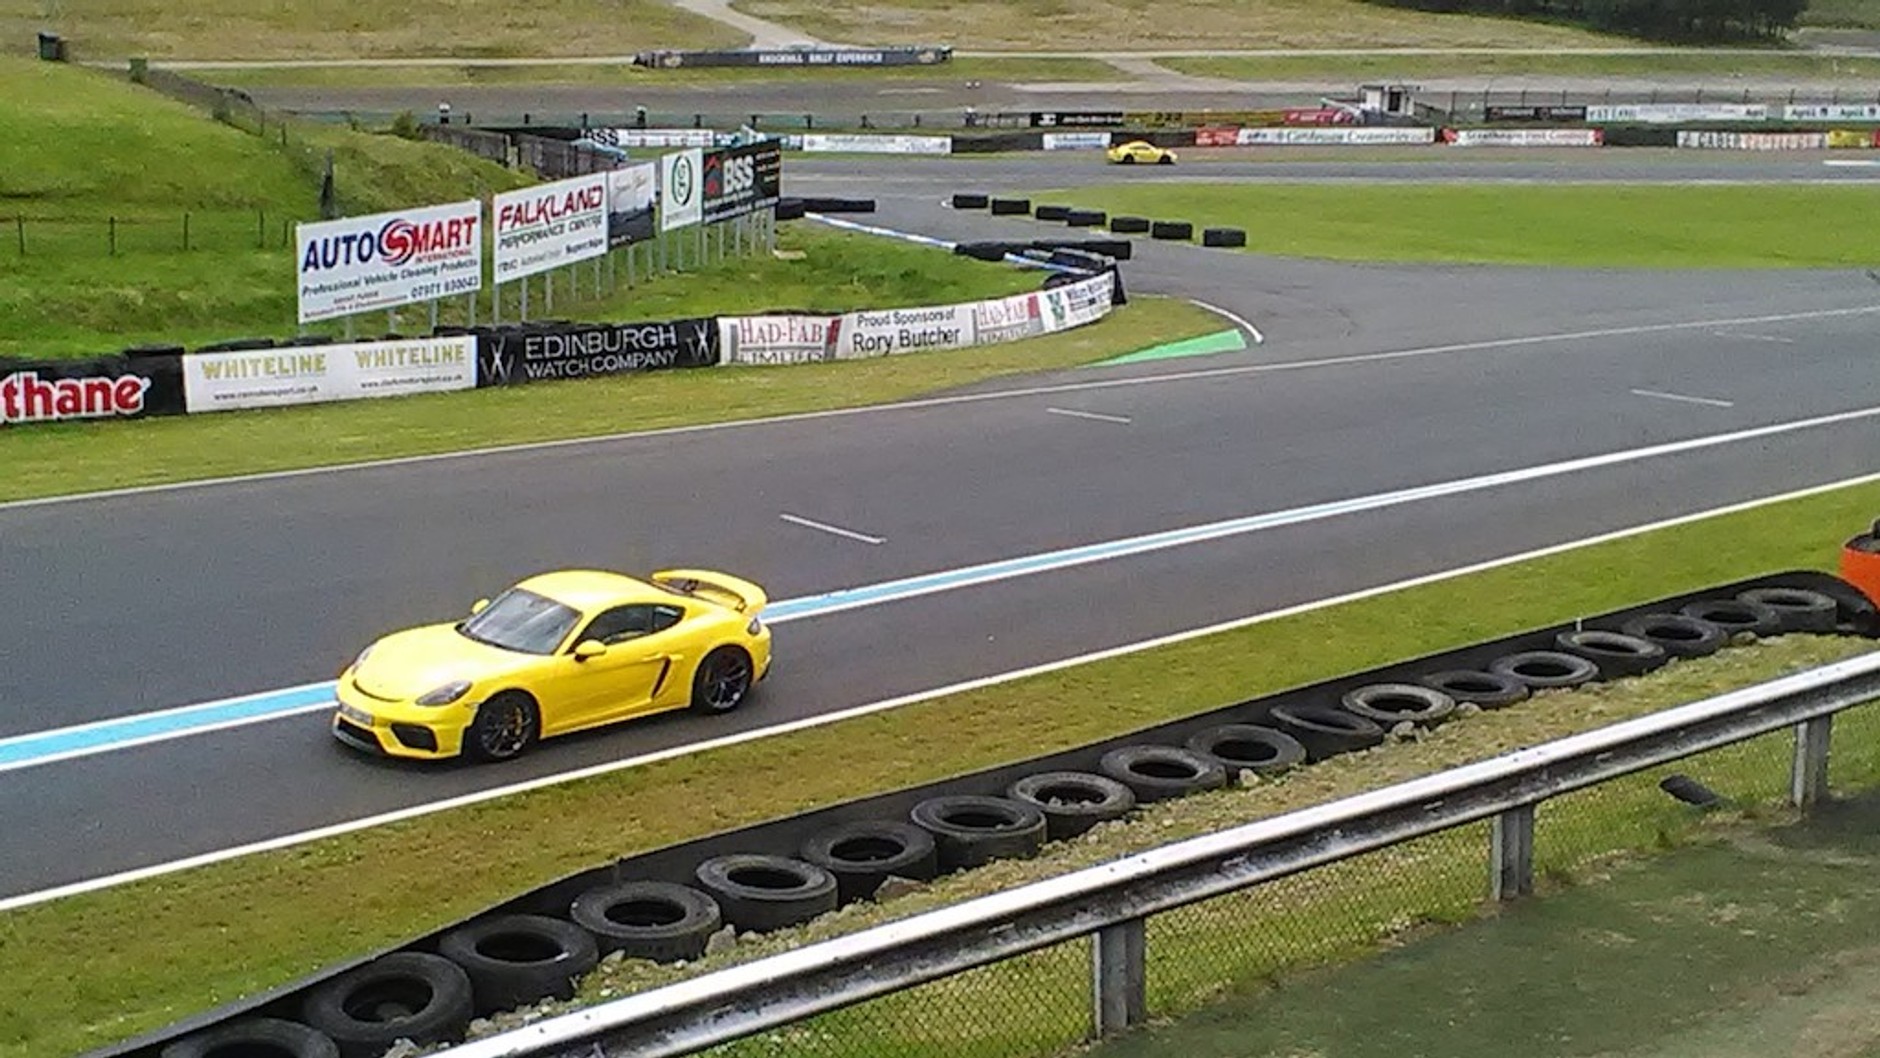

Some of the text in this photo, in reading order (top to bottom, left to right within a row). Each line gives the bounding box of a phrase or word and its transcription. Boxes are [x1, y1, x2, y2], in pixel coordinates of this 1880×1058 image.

[723, 155, 754, 195] BSS
[499, 184, 603, 230] FALKLAND
[302, 258, 478, 297] Professional Vehicle Cleaning Products
[740, 317, 822, 344] HAD-FAB
[857, 312, 891, 328] Proud
[893, 309, 943, 327] Sponsors
[354, 343, 464, 369] WHITELINE
[524, 325, 677, 359] EDINBURGH
[853, 326, 960, 357] Rory Butcher
[202, 353, 326, 380] WHITELINE
[524, 350, 678, 378] WATCH COMPANY
[0, 371, 146, 424] thane
